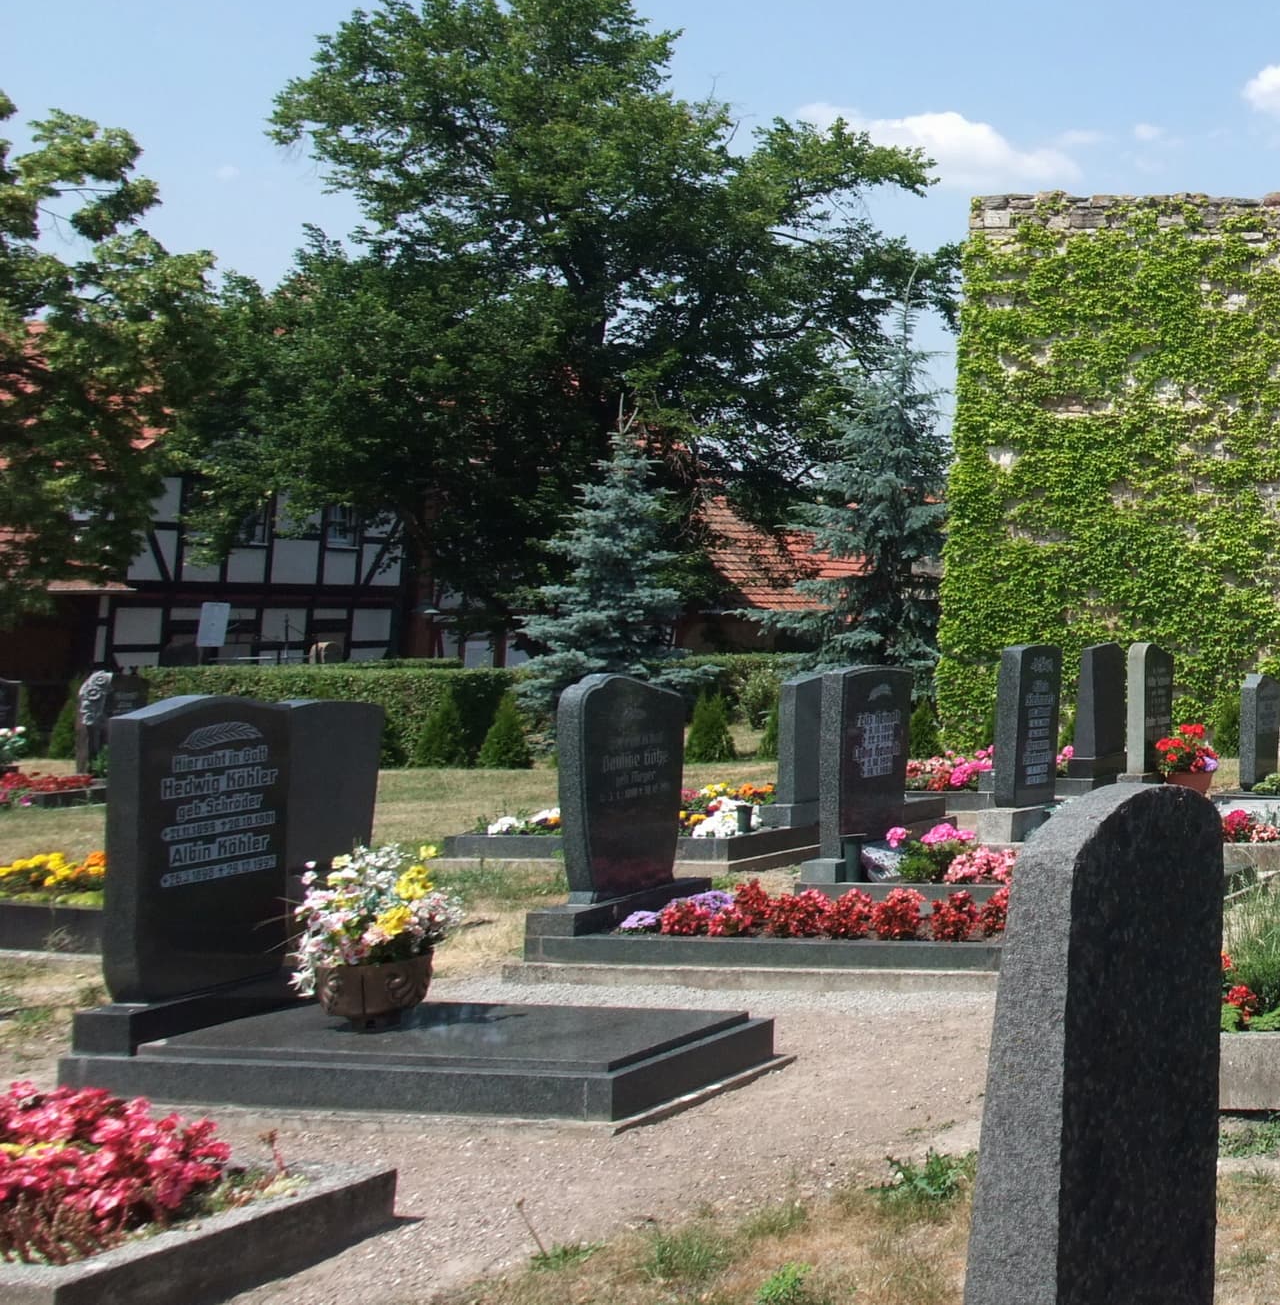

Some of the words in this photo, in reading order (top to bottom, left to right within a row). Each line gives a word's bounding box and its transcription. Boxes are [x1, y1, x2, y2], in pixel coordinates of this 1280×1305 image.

[173, 755, 200, 772] Hier
[201, 751, 226, 768] ruht
[228, 750, 240, 765] in
[242, 745, 268, 762] Gott
[162, 775, 220, 799] Hedwig
[225, 767, 277, 789] Köhler
[206, 793, 262, 813] Schröder
[171, 843, 211, 865] Albin
[217, 834, 269, 857] Köhler
